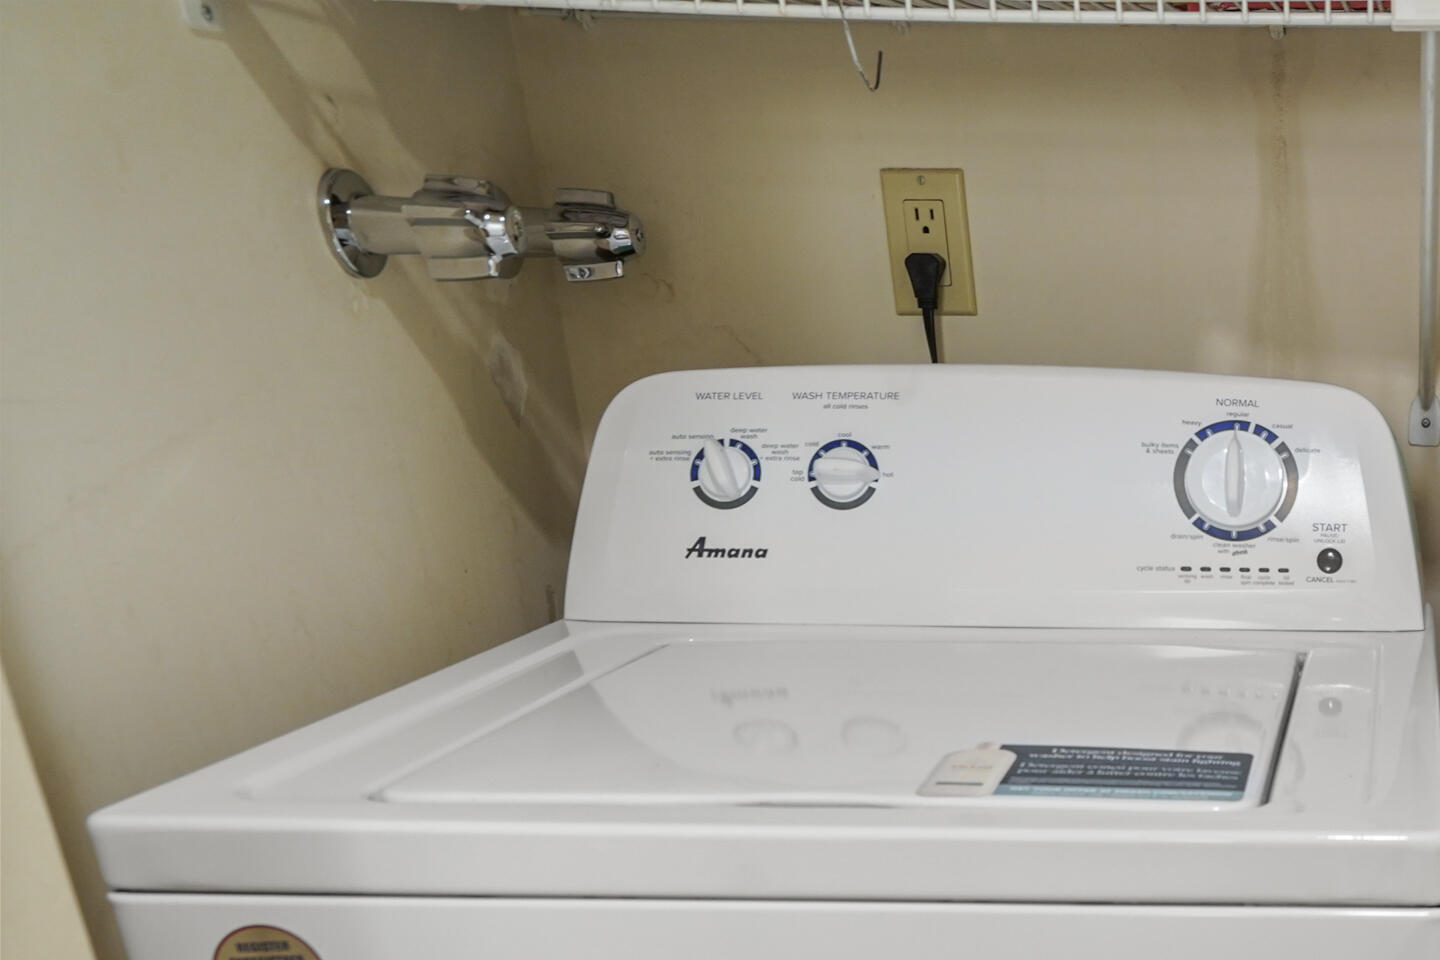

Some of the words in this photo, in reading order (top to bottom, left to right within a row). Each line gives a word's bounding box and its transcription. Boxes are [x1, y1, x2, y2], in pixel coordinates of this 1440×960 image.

[695, 392, 731, 400] WATER
[733, 392, 764, 400] LEVEL
[792, 392, 823, 400] WASH
[826, 392, 900, 400] TEMPERATURE
[1216, 398, 1260, 408] NORMAL
[1312, 522, 1349, 532] START
[685, 536, 769, 559] Amana
[1305, 576, 1333, 584] CANCEL
